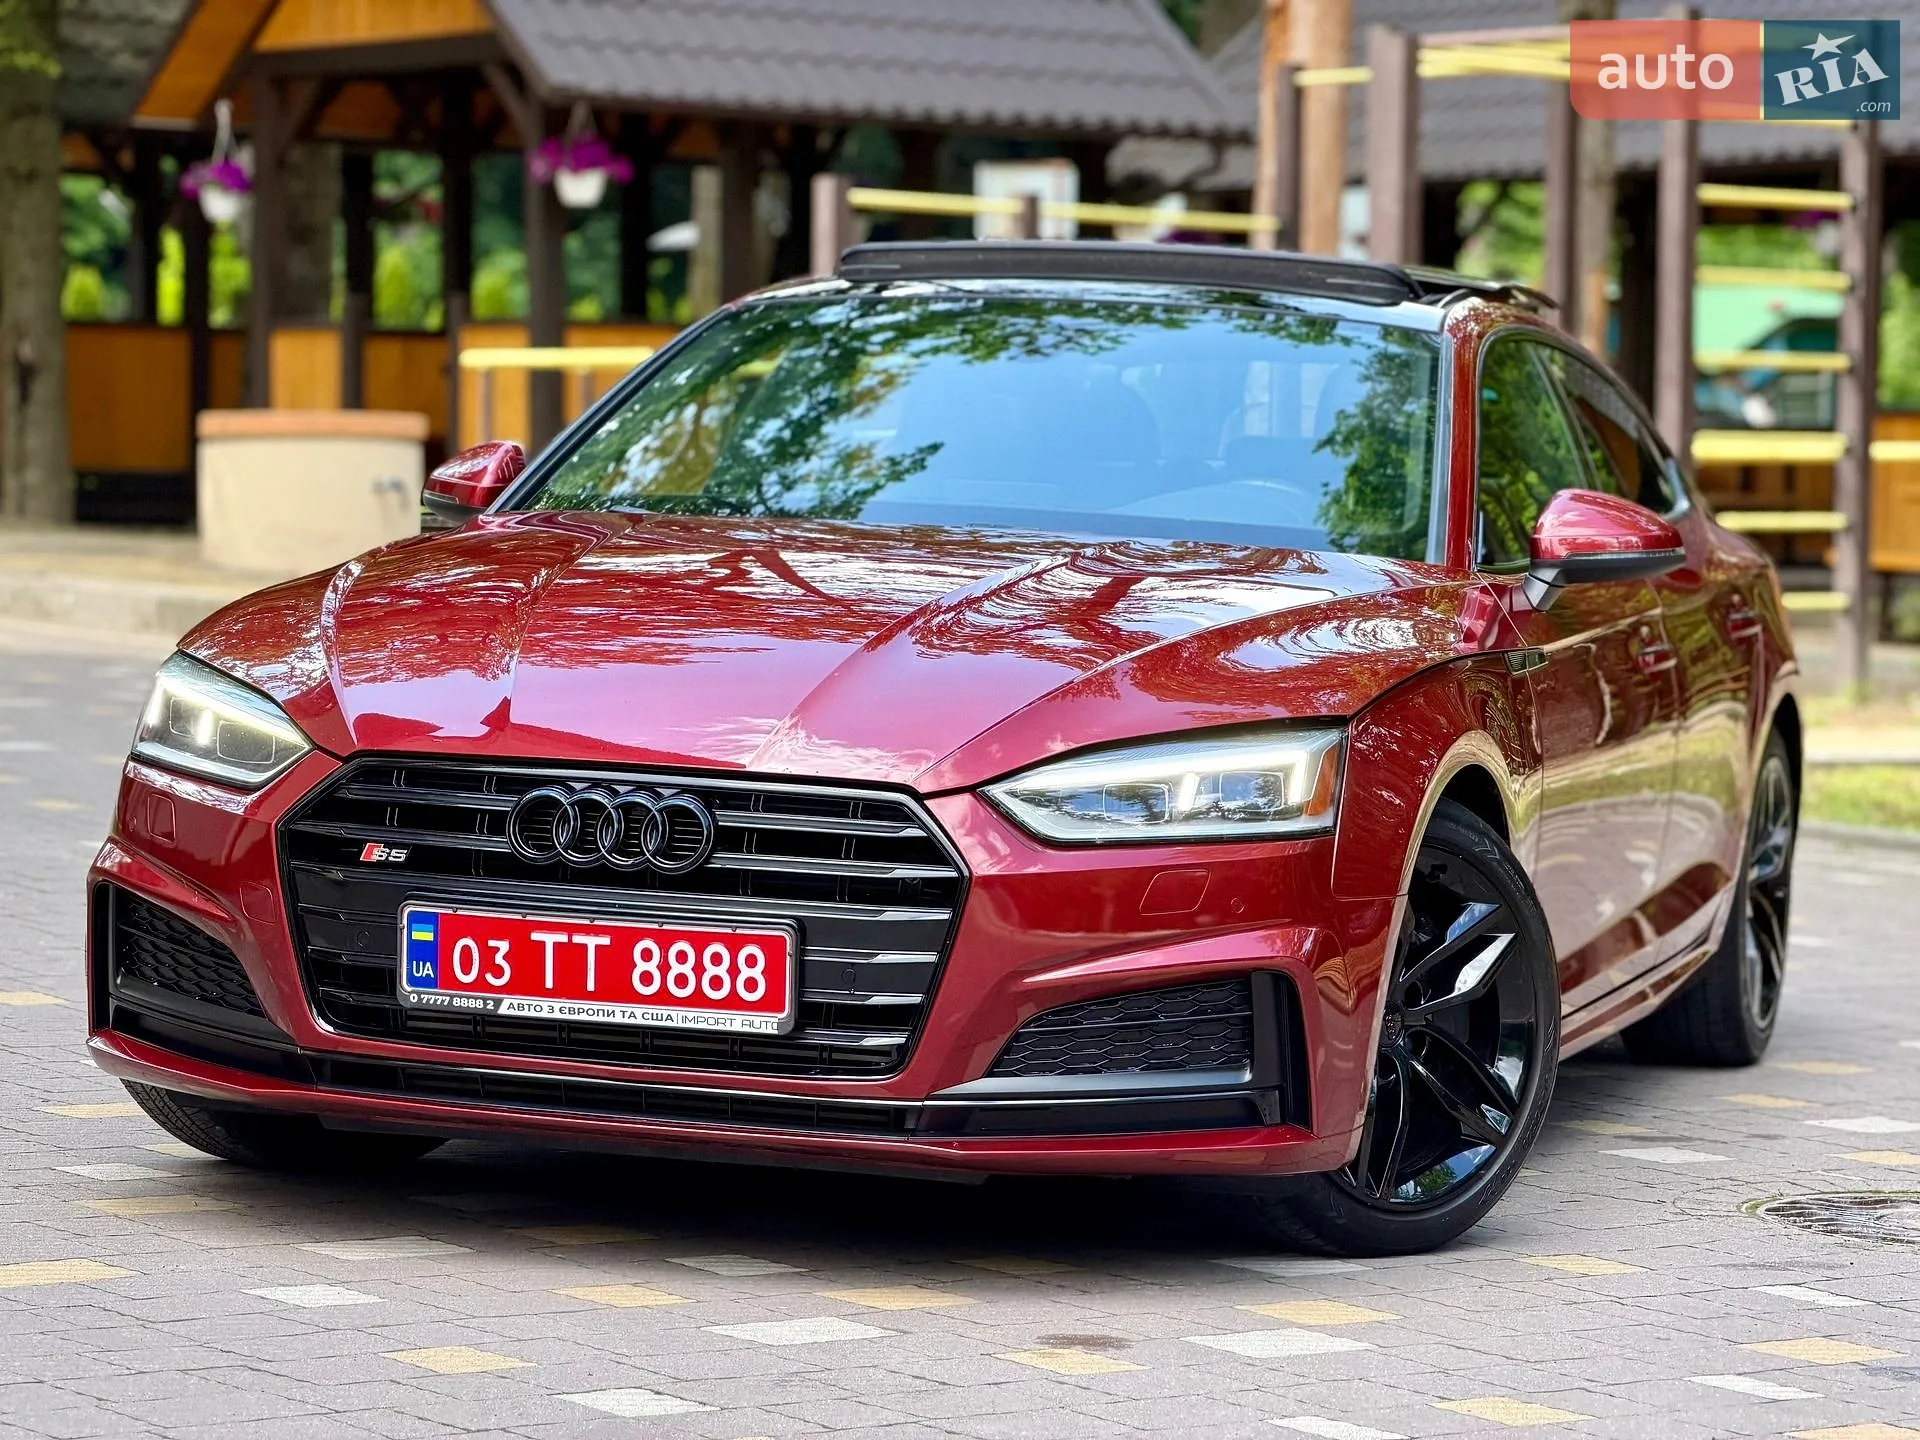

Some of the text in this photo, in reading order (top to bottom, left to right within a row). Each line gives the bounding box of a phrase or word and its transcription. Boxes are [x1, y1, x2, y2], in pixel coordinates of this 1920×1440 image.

[412, 961, 435, 978] UA
[452, 931, 767, 1002] 03 TT 8888
[409, 993, 495, 1010] 0 7777 8888 2
[507, 1002, 543, 1013] АВТО
[559, 1006, 616, 1018] ЄВРОПИ
[620, 1010, 638, 1020] ТА
[641, 1012, 675, 1023] США
[681, 1015, 737, 1028] IMPORT
